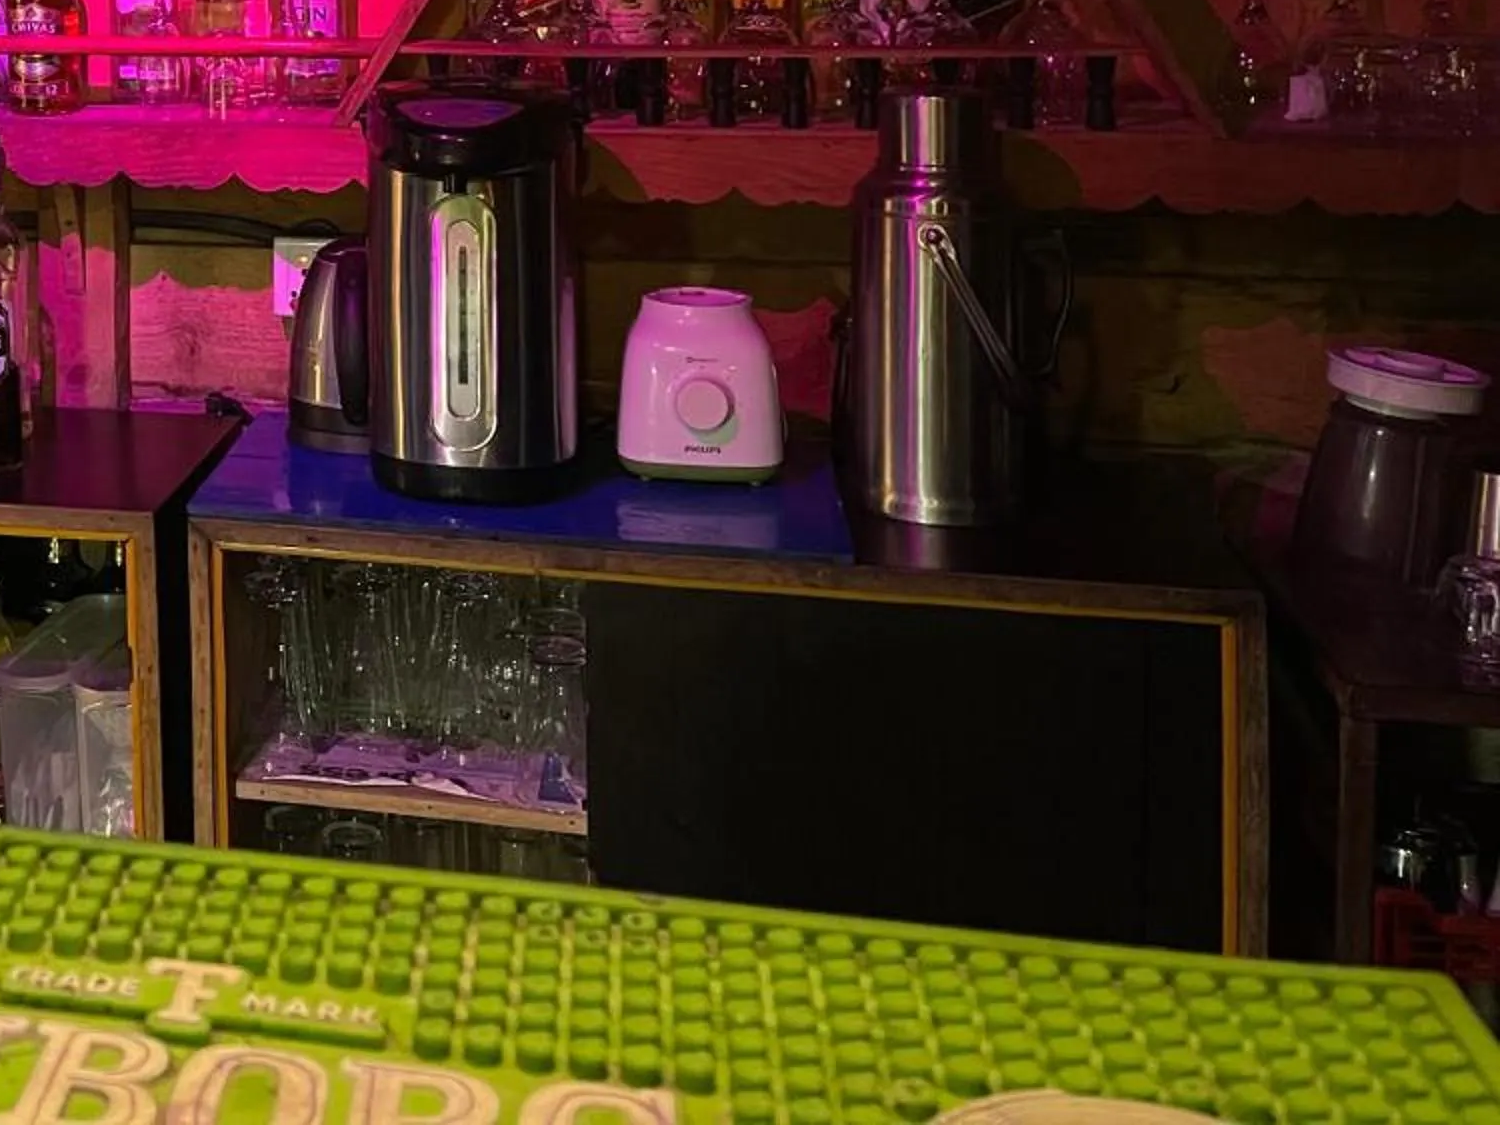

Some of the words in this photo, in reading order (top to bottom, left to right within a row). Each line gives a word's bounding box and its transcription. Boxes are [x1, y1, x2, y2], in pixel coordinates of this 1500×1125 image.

[11, 21, 57, 34] CHIVAS
[10, 965, 142, 997] TRADE
[242, 991, 380, 1023] MARK
